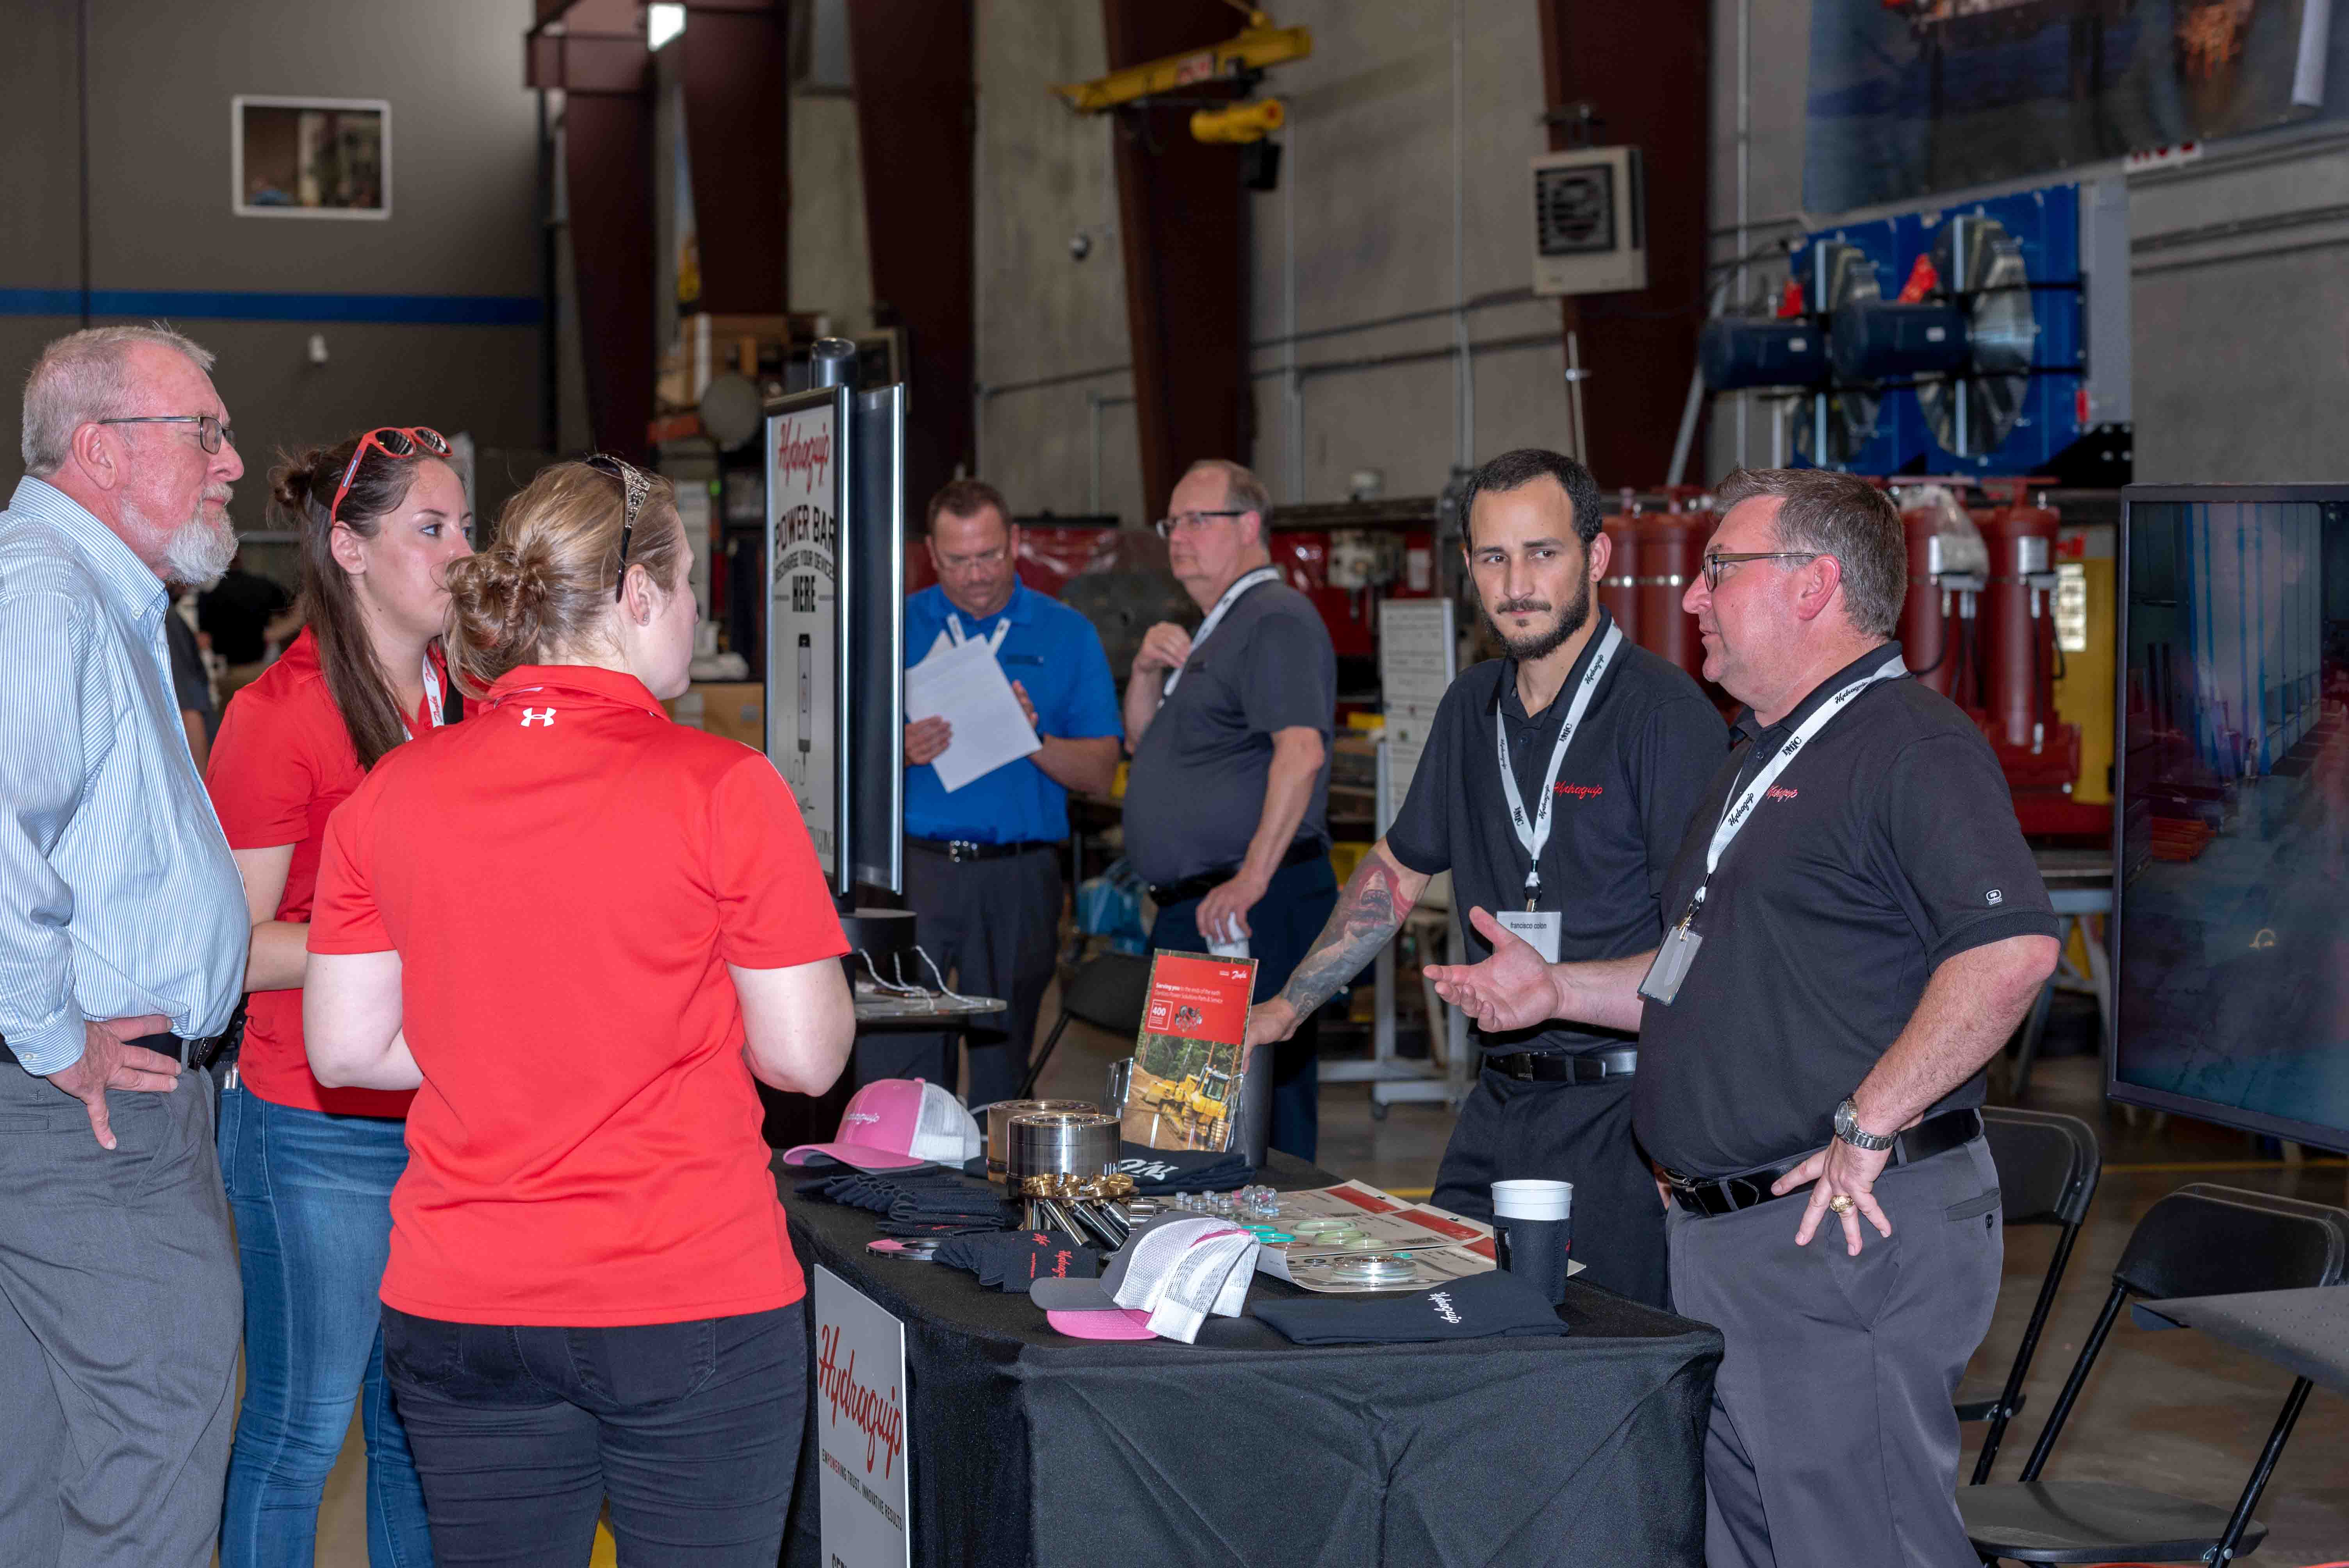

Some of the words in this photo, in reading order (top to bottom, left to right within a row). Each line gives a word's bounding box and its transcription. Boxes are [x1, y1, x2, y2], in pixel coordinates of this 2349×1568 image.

[775, 504, 809, 559] POWER
[814, 505, 835, 553] BAR
[793, 576, 815, 613] HERE
[1554, 780, 1603, 800] Hydraquip
[1728, 793, 1754, 827] Hydraquip
[1153, 1007, 1166, 1016] 400
[819, 1324, 902, 1480] Hydraquip
[822, 1449, 846, 1481] EMPOWERING
[862, 1482, 884, 1515] INNOVATIVE
[885, 1504, 902, 1531] RESULTS
